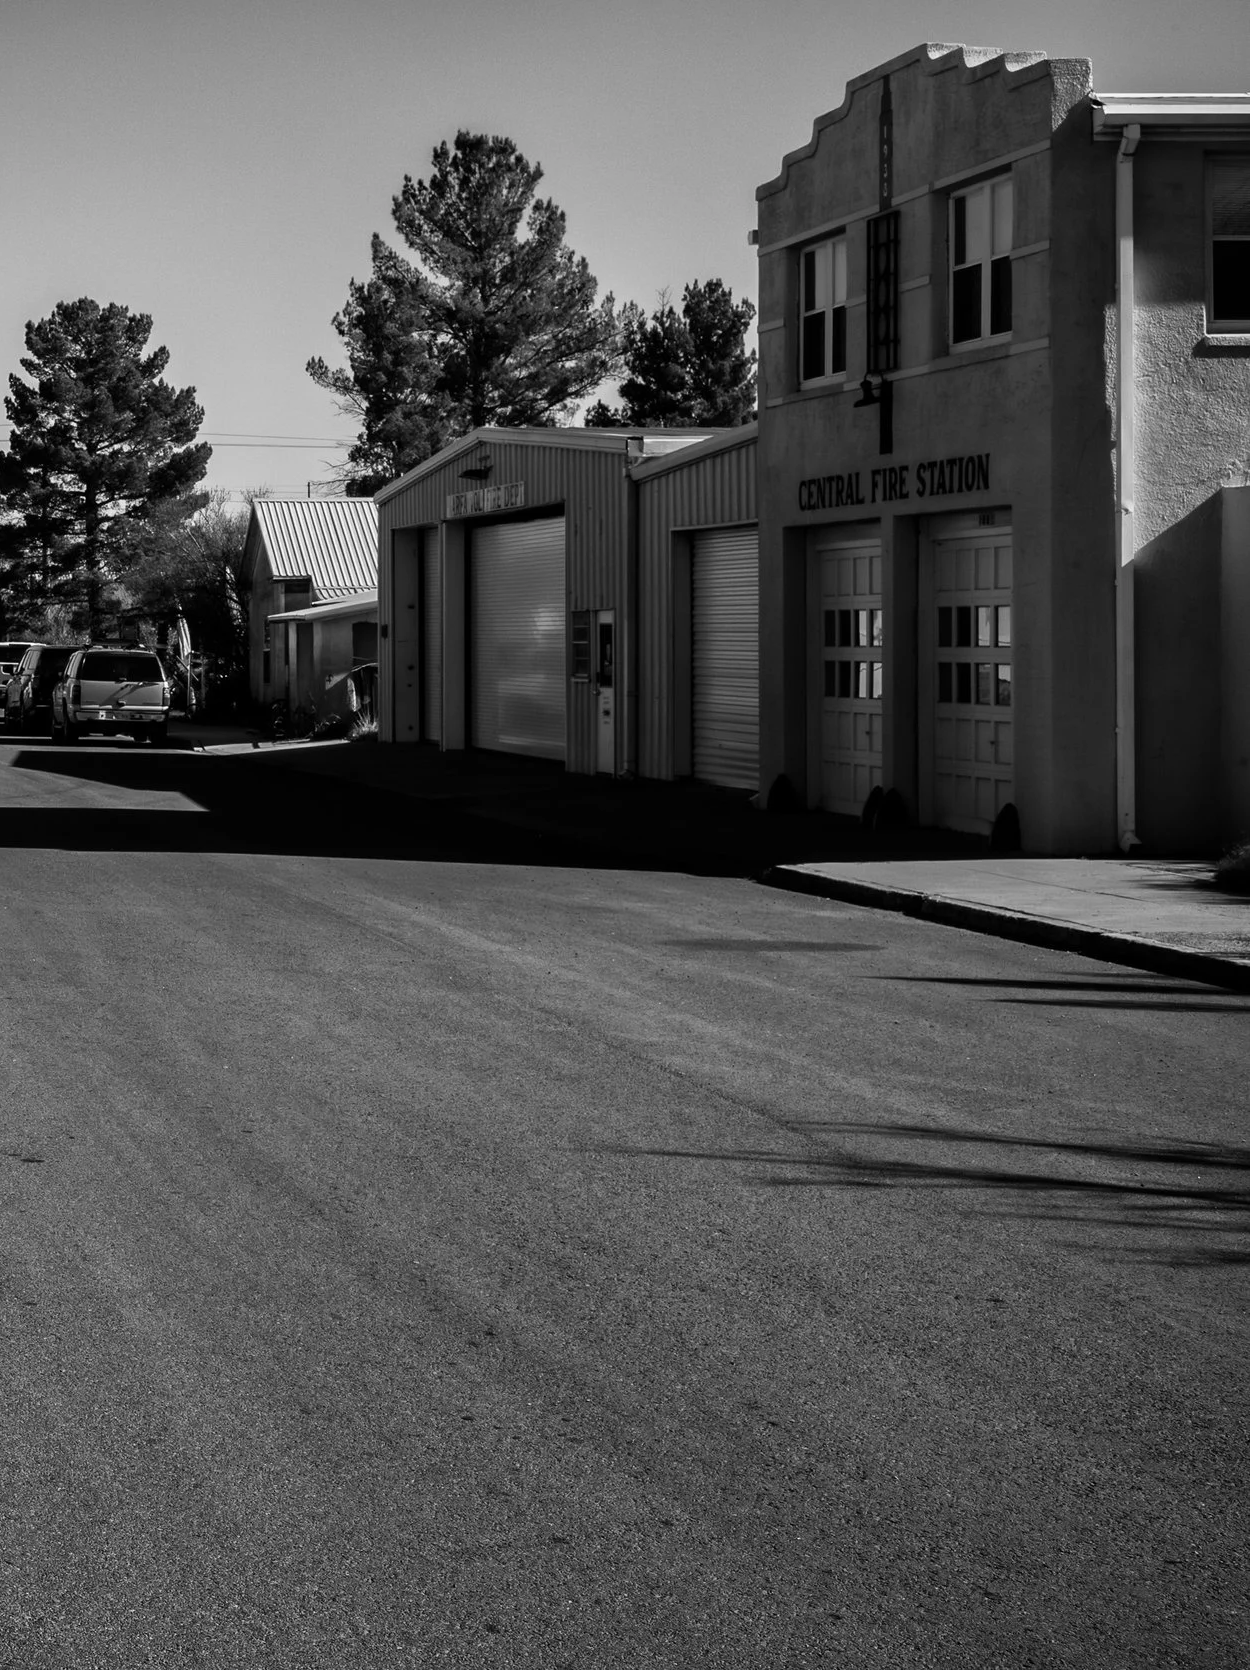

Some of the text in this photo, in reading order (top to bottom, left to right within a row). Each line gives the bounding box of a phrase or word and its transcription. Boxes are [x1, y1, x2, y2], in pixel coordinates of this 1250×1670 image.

[798, 453, 991, 512] CENTRAL FIRE STATION
